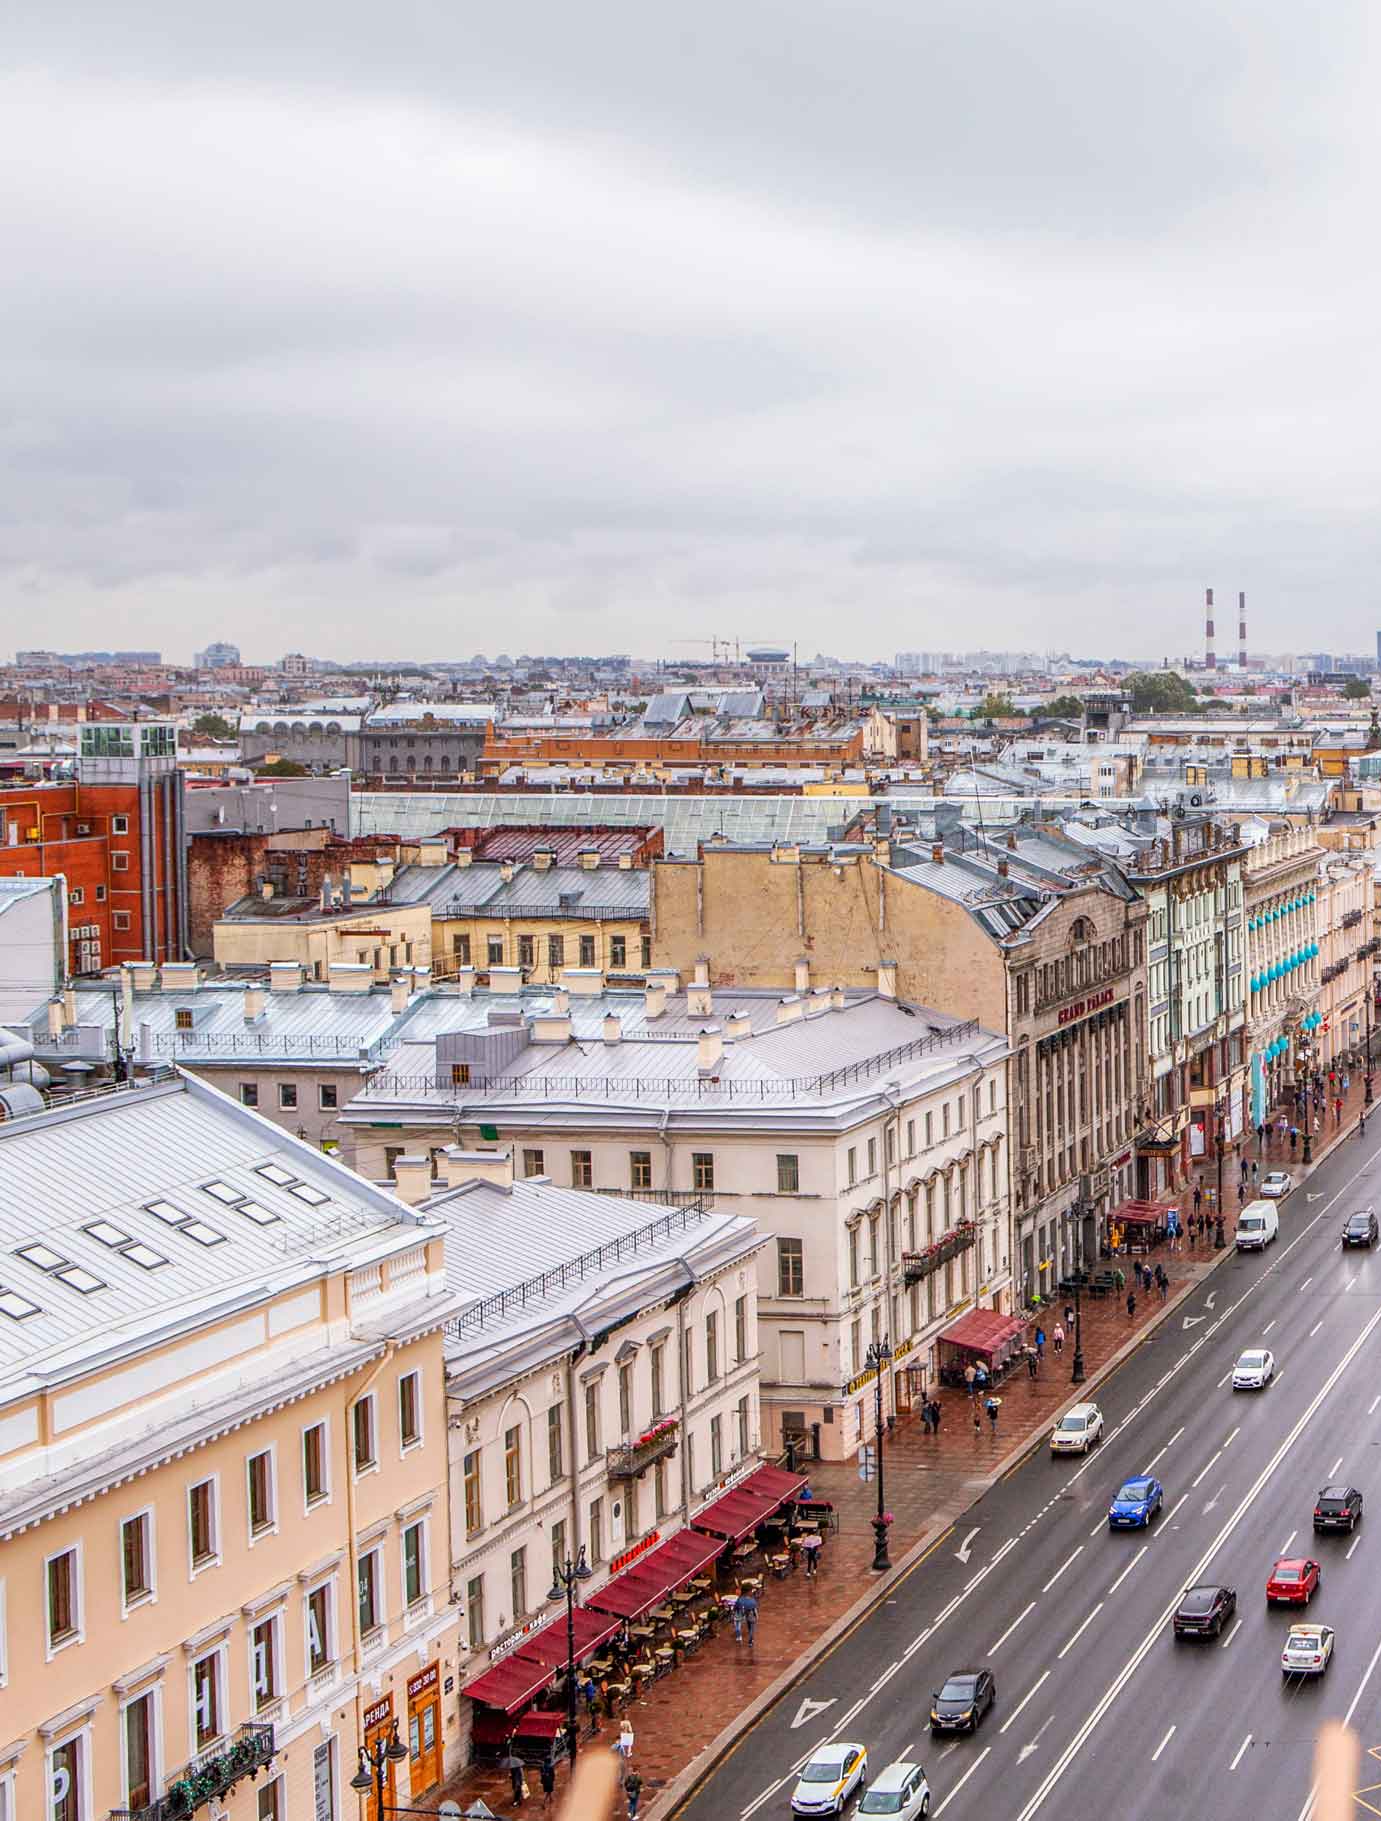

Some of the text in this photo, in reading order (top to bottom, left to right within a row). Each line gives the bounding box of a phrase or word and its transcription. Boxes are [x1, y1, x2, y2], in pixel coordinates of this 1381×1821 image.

[1058, 1001, 1086, 1025] GRAND
[491, 1613, 547, 1661] ресторан кафе
[363, 1700, 390, 1729] РЕНДА
